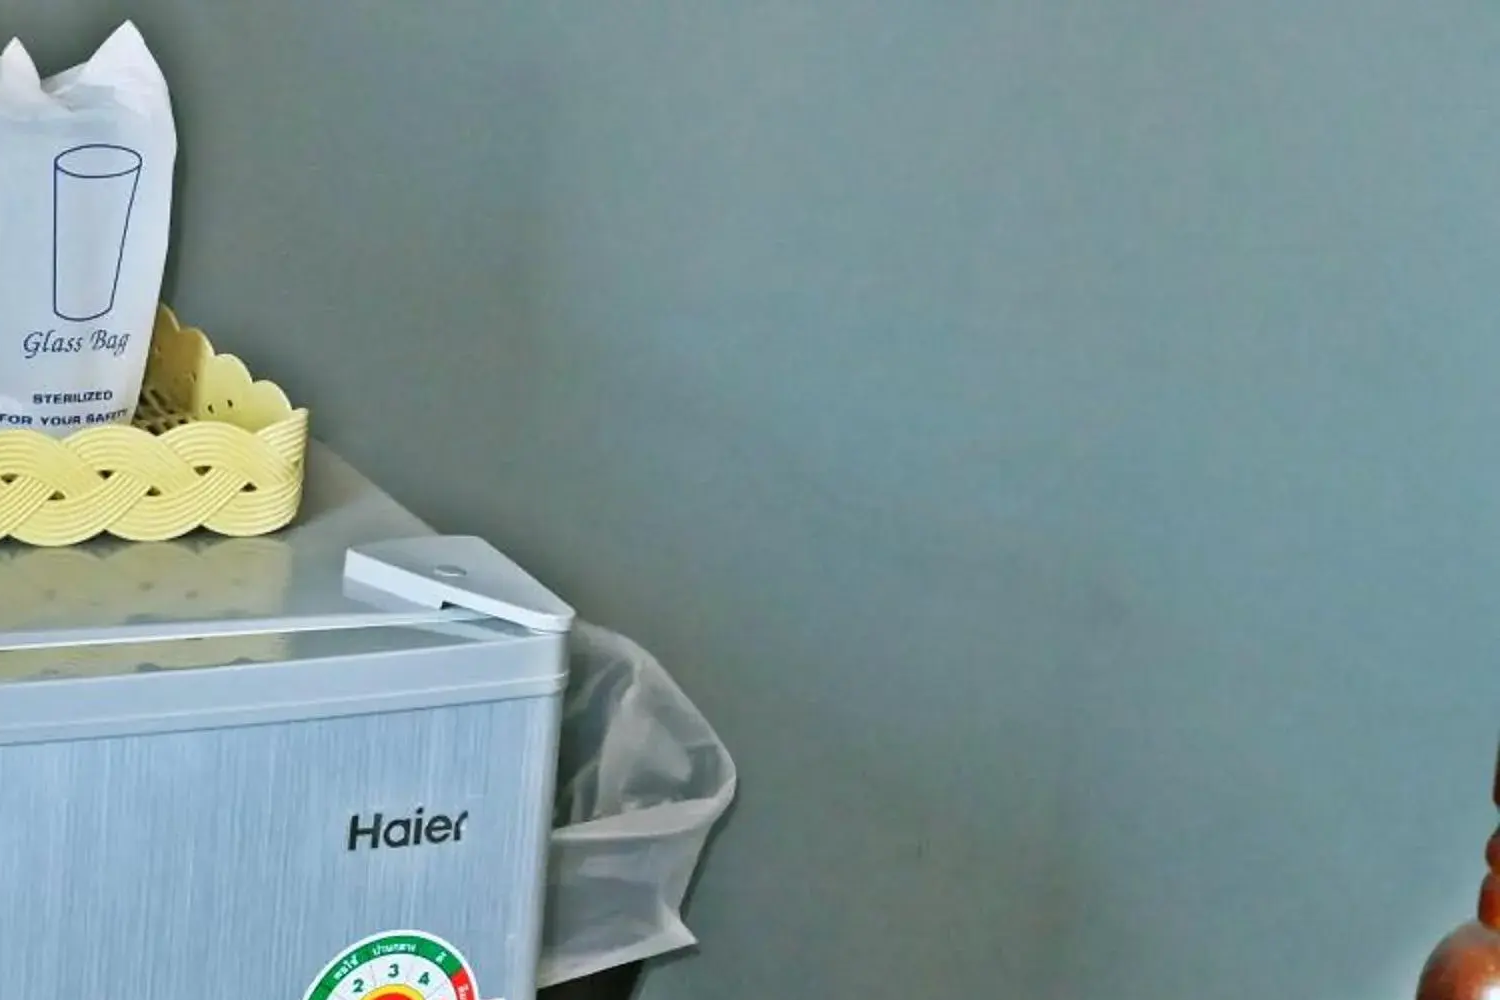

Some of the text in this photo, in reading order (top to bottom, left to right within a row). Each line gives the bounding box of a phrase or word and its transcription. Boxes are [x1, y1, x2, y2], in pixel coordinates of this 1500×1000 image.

[22, 327, 131, 359] Glass Bag
[32, 389, 114, 405] STERILIZED
[40, 414, 82, 426] YOUR
[347, 807, 469, 851] Haier
[387, 963, 400, 979] 3
[417, 971, 431, 986] 4
[353, 978, 365, 993] 2
